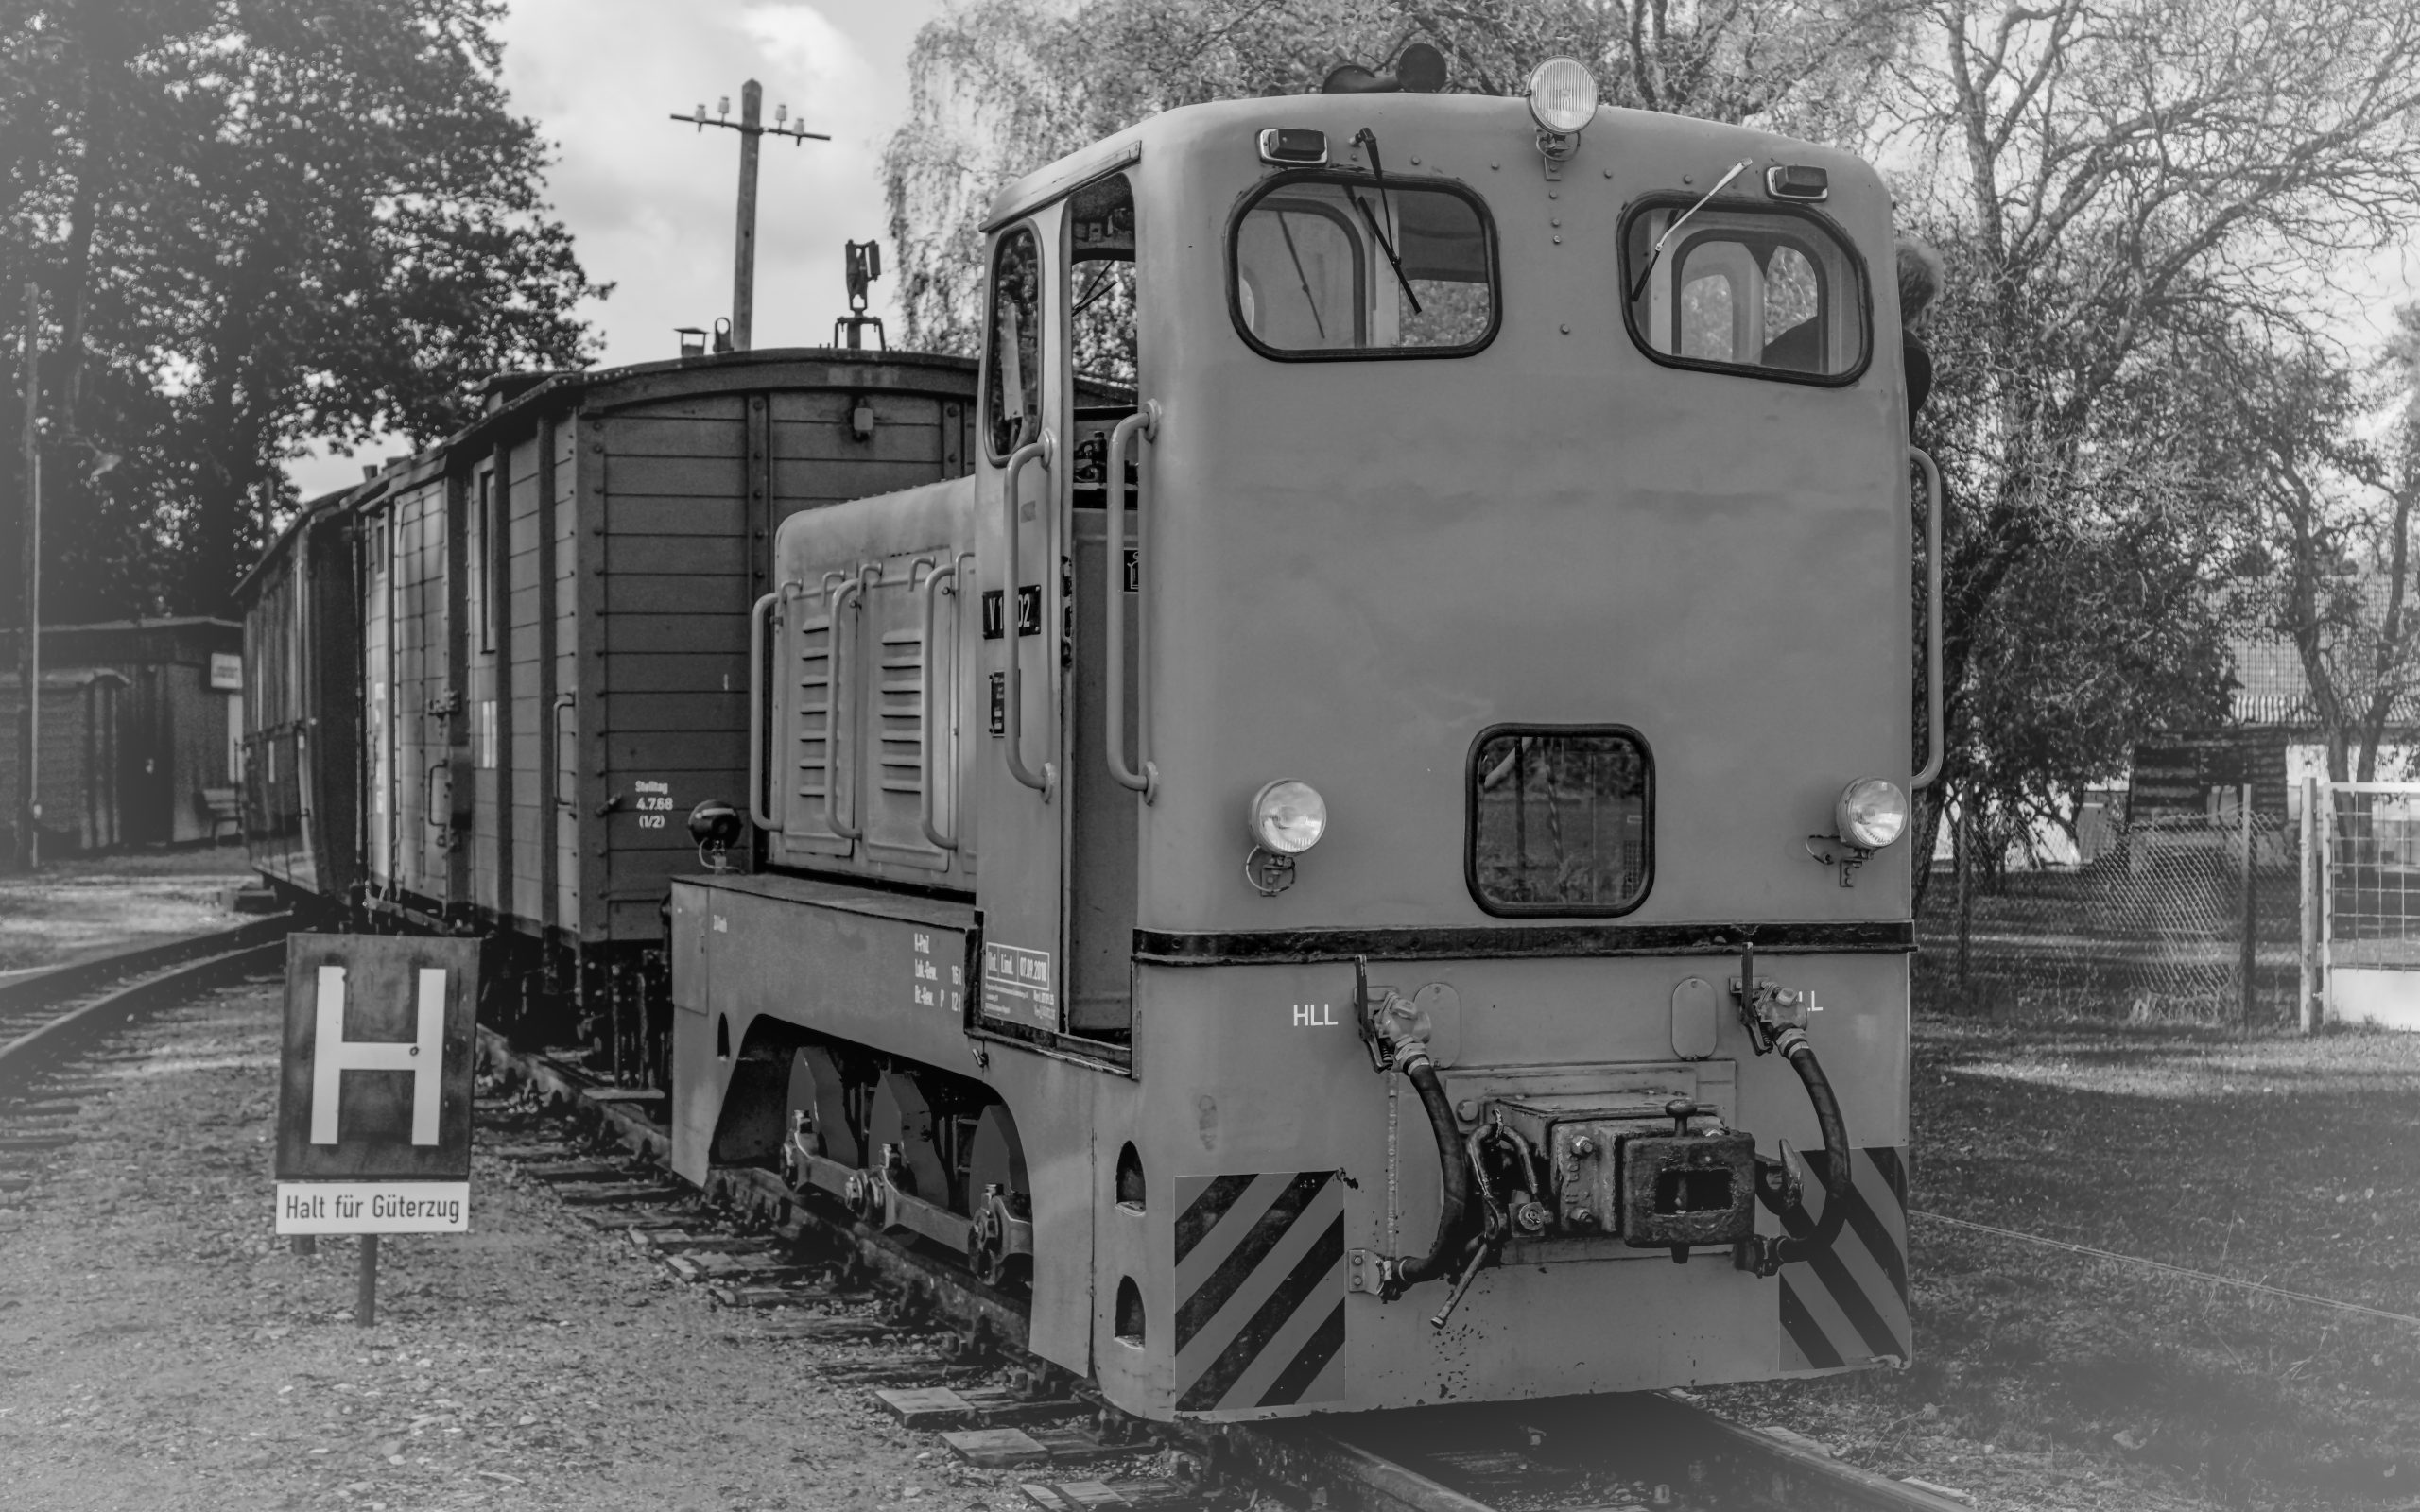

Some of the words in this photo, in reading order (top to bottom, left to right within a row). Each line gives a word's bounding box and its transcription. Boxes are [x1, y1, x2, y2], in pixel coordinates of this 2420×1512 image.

[639, 815, 666, 829] (1/2)
[1293, 1004, 1339, 1026] HLL
[310, 966, 446, 1146] H
[286, 1194, 325, 1219] Halt
[335, 1194, 364, 1219] für
[372, 1193, 459, 1224] Güterzug
